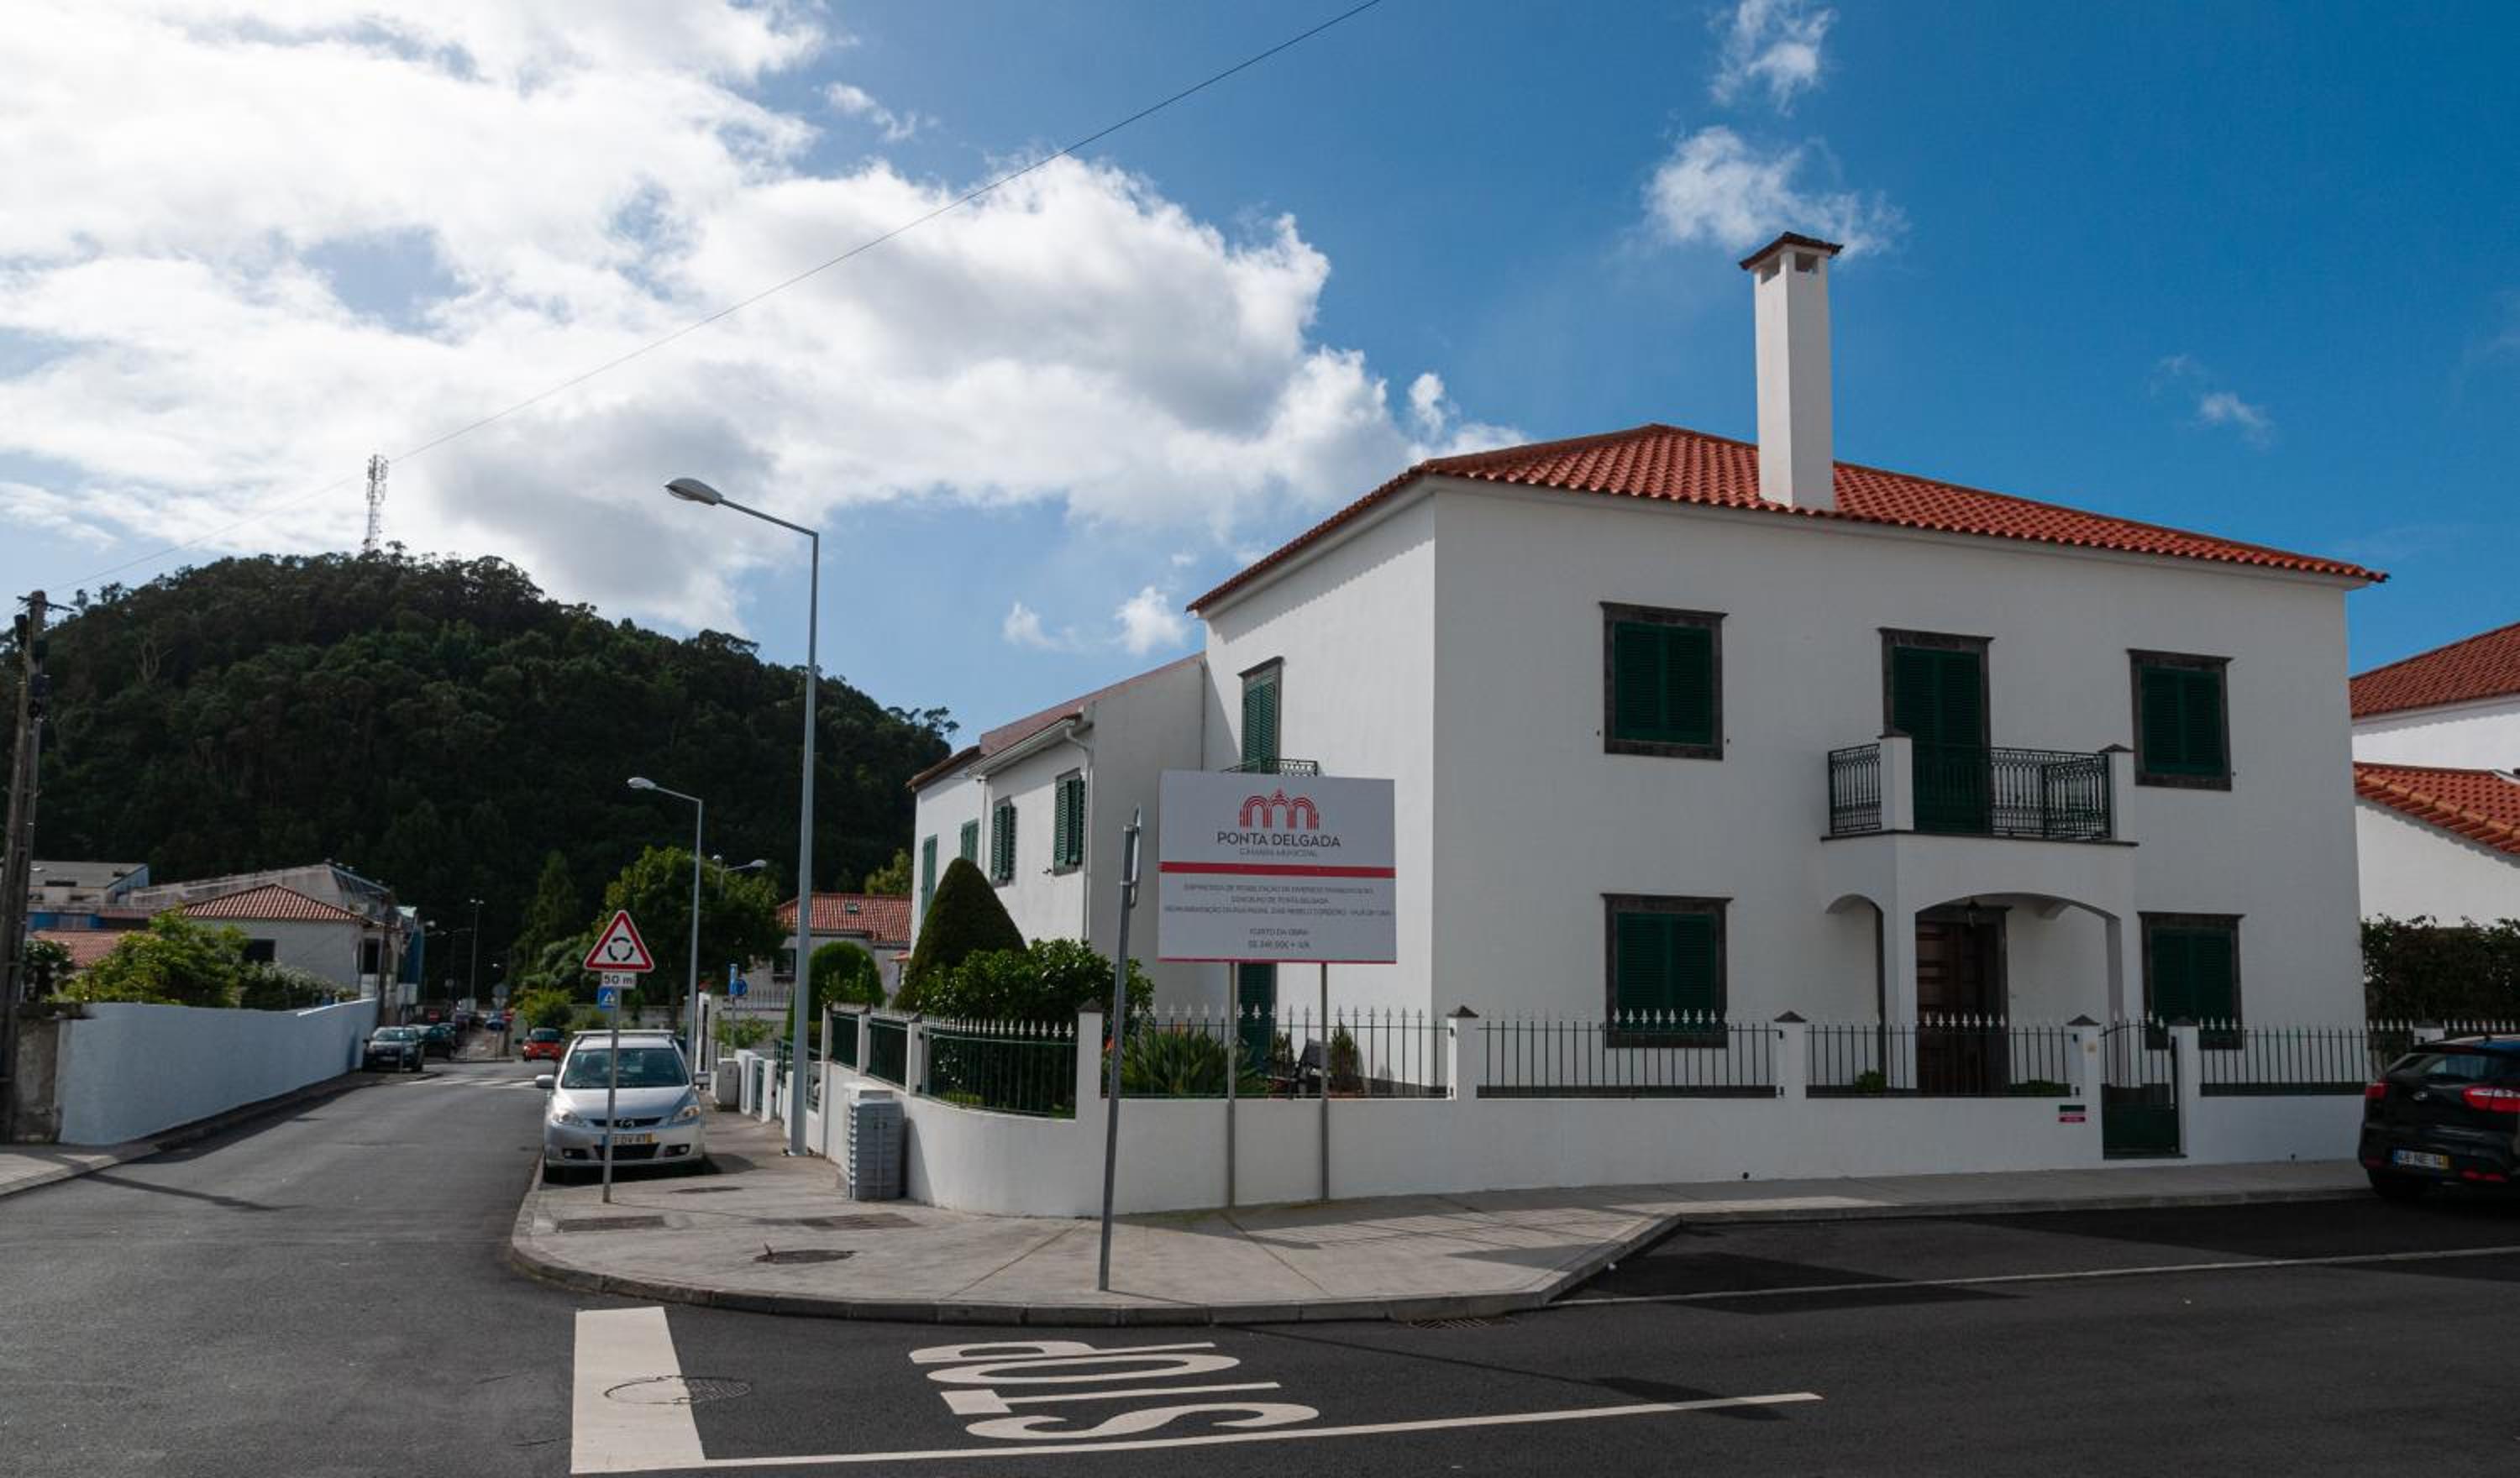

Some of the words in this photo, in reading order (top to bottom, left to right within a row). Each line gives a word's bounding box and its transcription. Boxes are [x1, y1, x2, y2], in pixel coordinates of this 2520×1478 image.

[1217, 831, 1268, 845] PONTA
[1272, 834, 1341, 847] DELGADA
[604, 974, 619, 985] 50
[622, 977, 633, 985] m
[909, 1341, 1320, 1439] STOP
